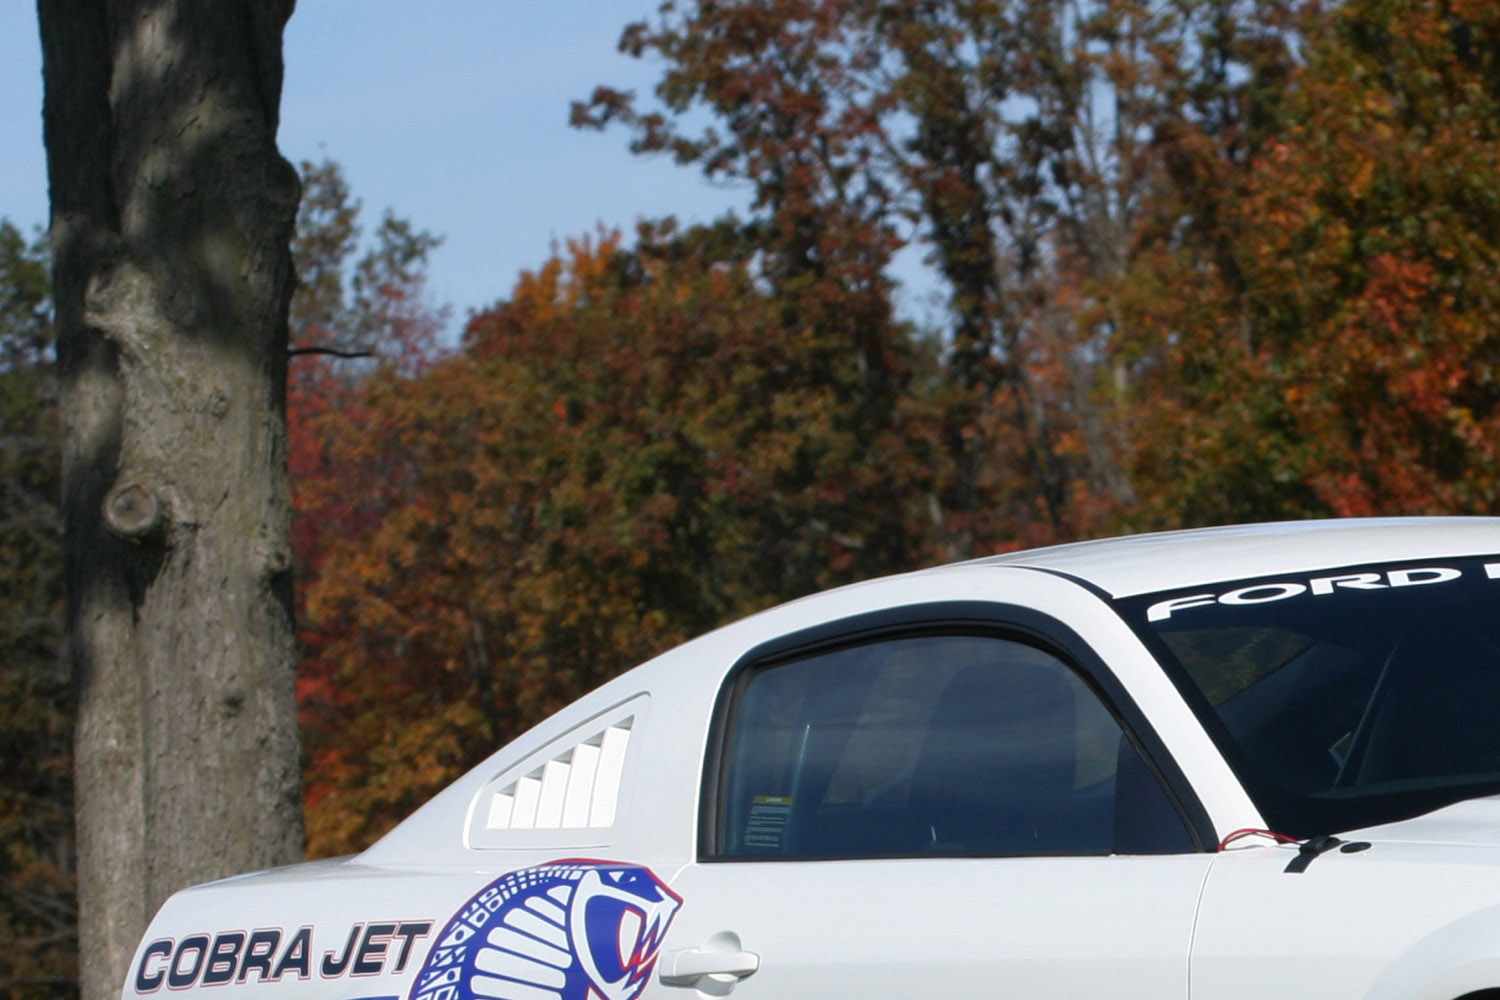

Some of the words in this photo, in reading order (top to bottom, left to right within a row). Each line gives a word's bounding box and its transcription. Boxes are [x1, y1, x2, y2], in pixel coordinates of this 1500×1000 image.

[1147, 567, 1463, 622] FORD
[135, 925, 315, 995] COBRA
[320, 919, 436, 979] JET
